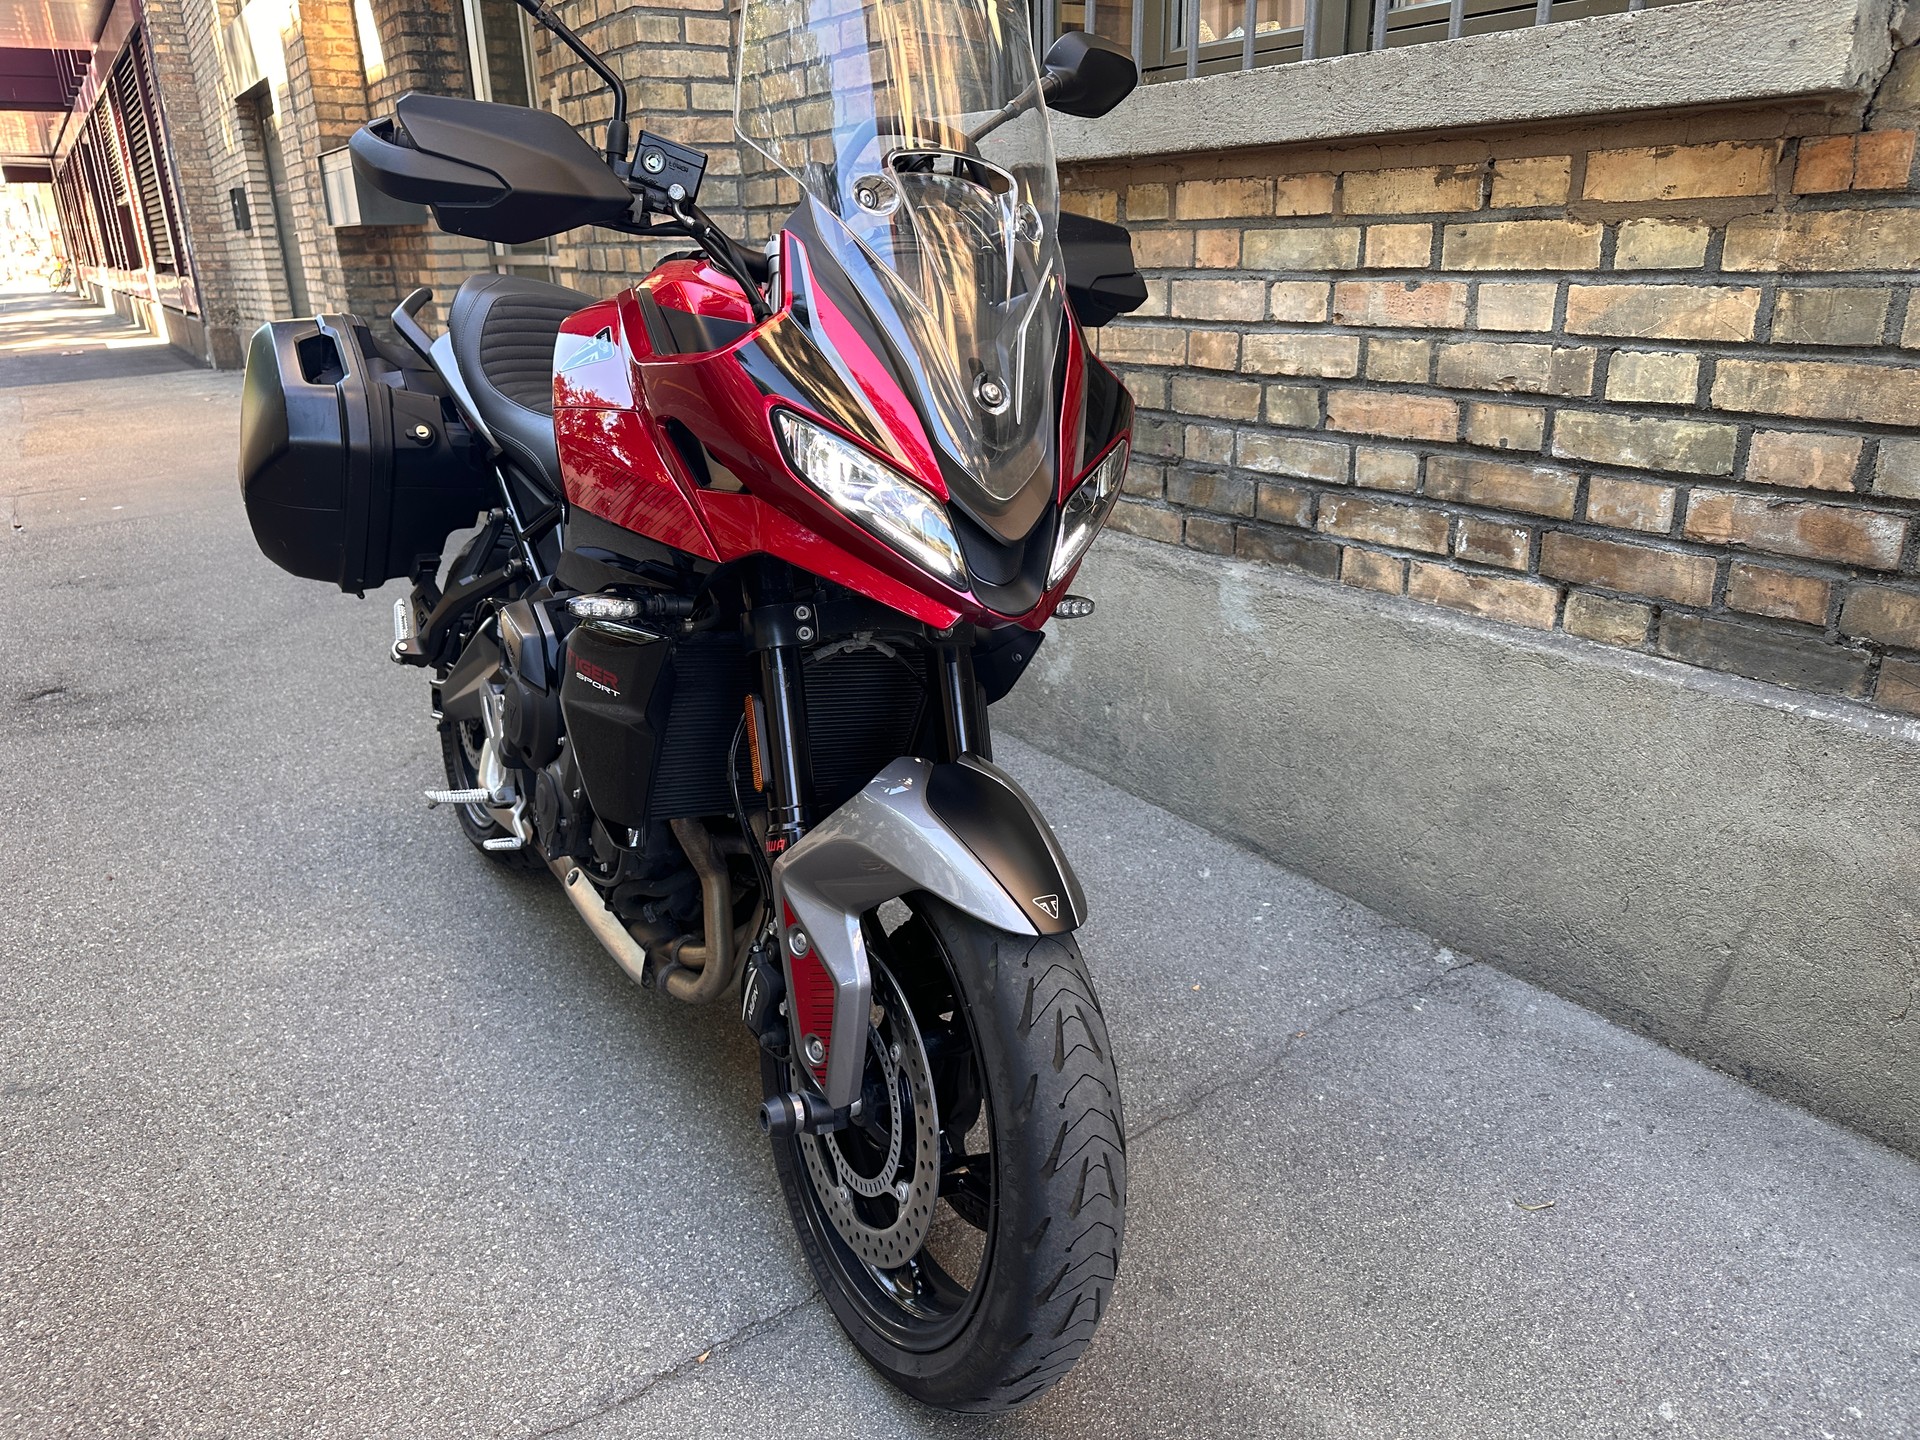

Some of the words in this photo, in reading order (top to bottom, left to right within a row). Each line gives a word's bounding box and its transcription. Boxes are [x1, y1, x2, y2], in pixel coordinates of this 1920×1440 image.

[567, 647, 620, 690] TIGER
[576, 672, 620, 696] SPORT
[786, 1184, 831, 1280] MICHELIN
